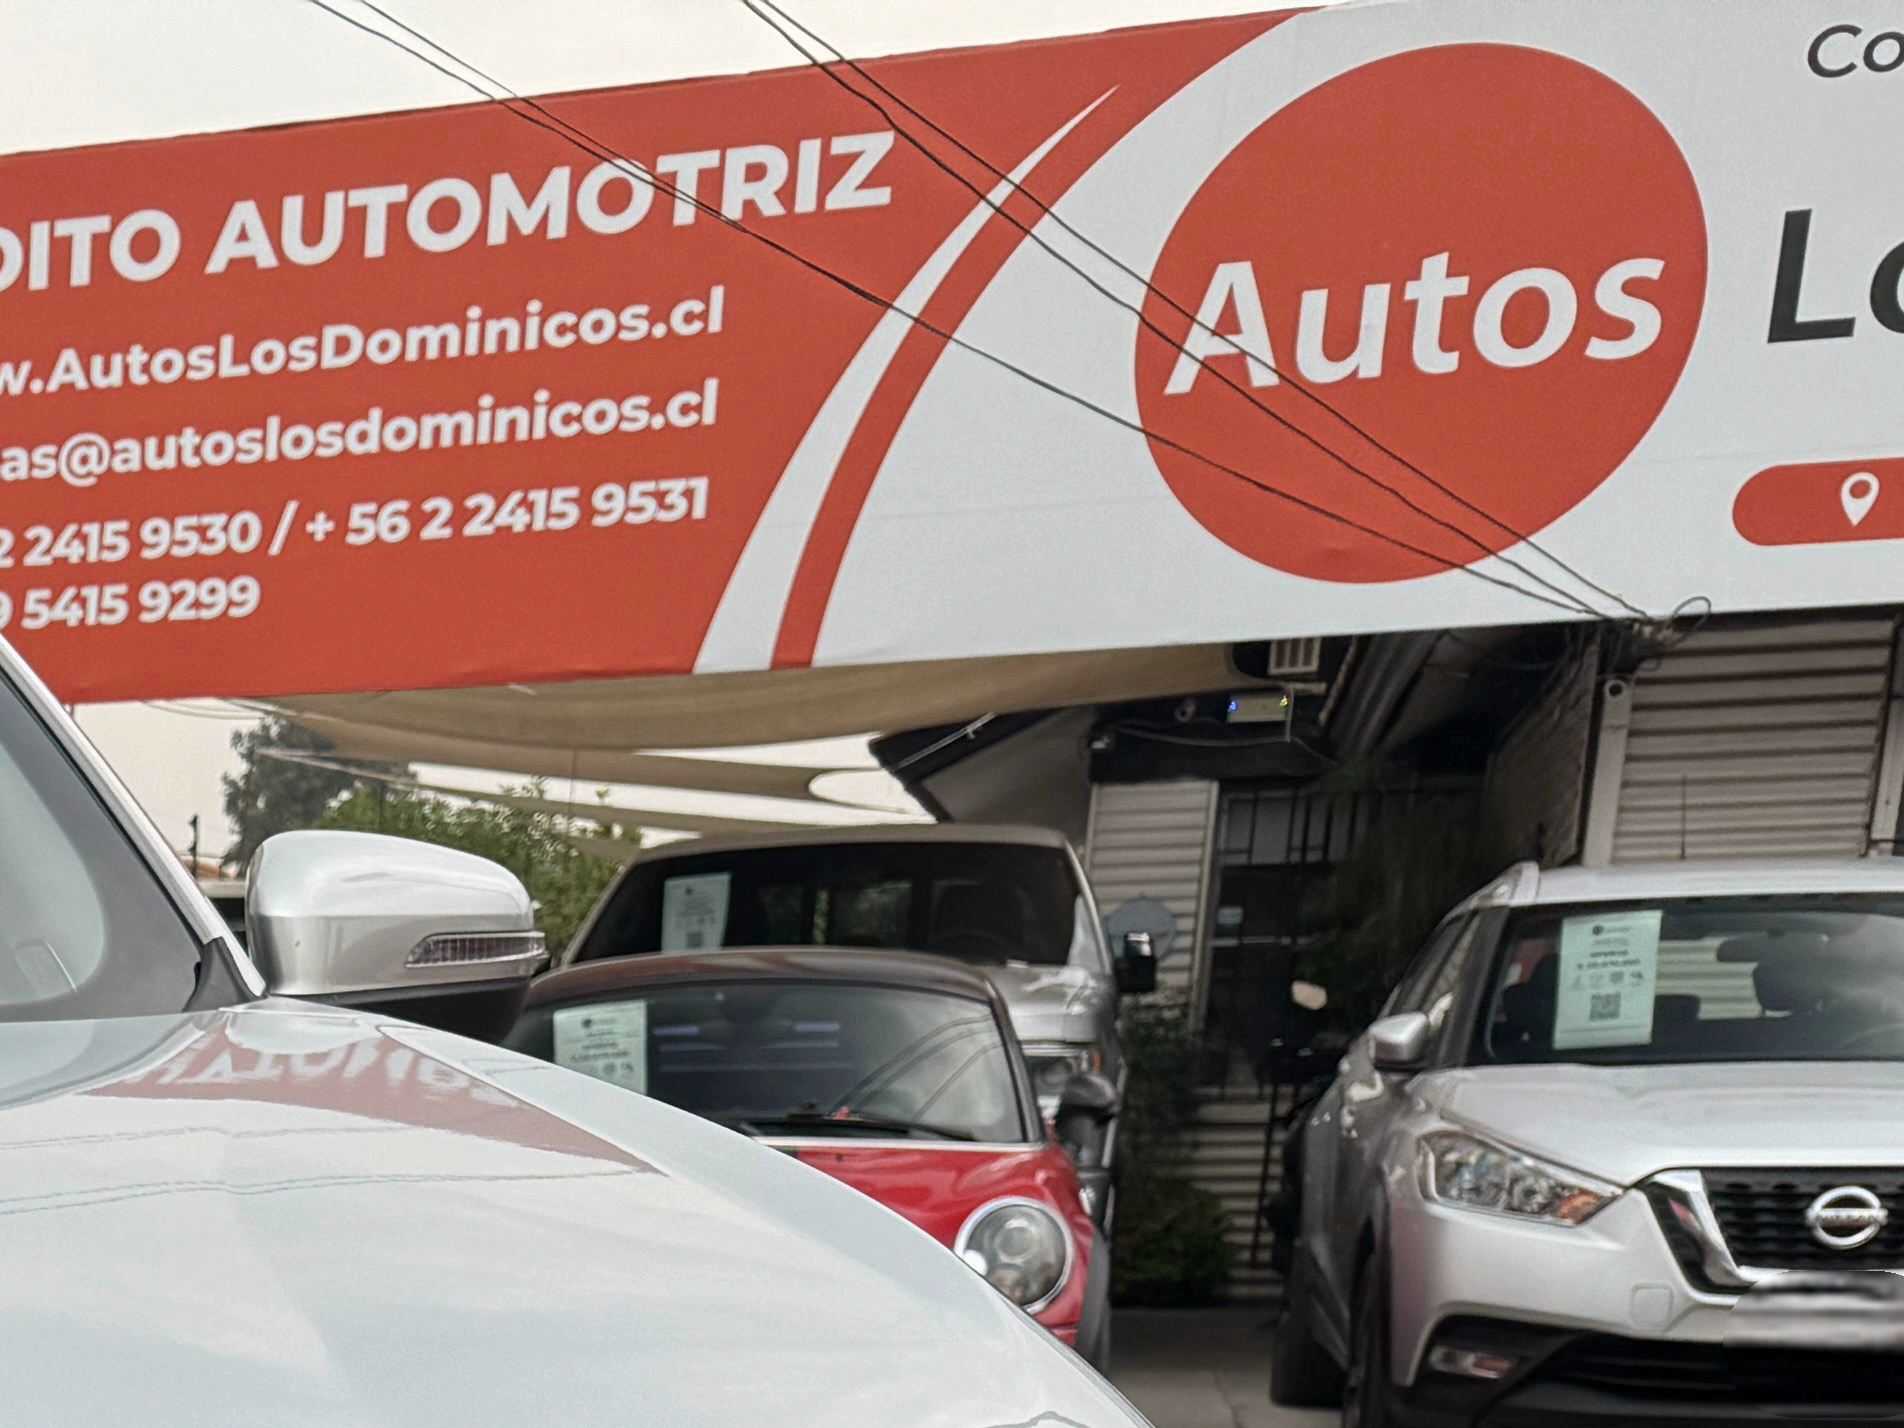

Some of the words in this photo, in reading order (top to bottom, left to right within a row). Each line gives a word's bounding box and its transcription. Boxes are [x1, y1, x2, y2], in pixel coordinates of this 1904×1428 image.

[204, 129, 895, 275] AUTOMOTRIZ
[1163, 251, 1666, 396] Autos
[22, 519, 131, 567] 2415
[139, 510, 263, 560] 9530
[267, 499, 300, 556] /
[345, 499, 411, 546] 56
[419, 496, 454, 541] 2
[462, 486, 581, 537] 2415
[591, 475, 710, 528] 9531
[21, 583, 129, 630] 5415
[138, 575, 261, 623] 9299
